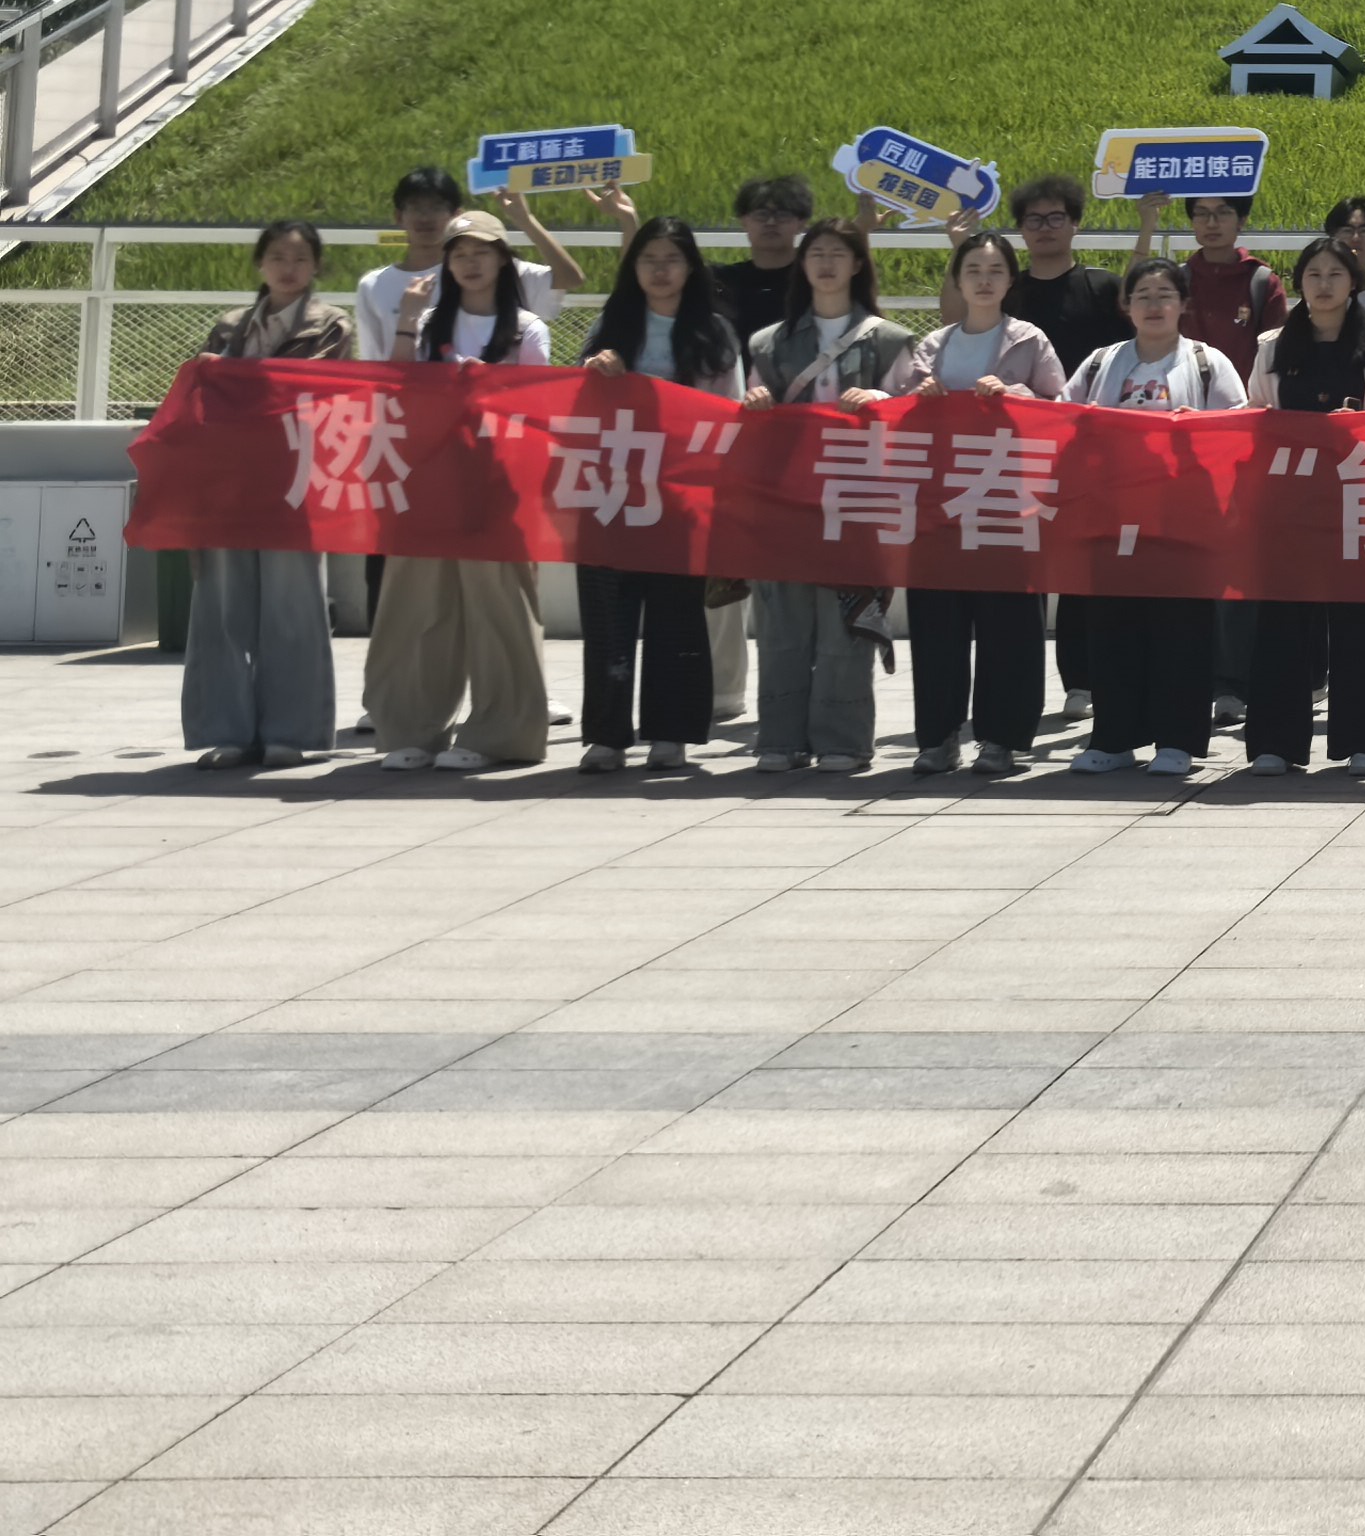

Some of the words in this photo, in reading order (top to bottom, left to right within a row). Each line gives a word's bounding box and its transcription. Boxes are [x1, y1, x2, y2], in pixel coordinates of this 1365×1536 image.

[878, 139, 928, 174] 匠心
[1134, 155, 1254, 179] 能动担使命
